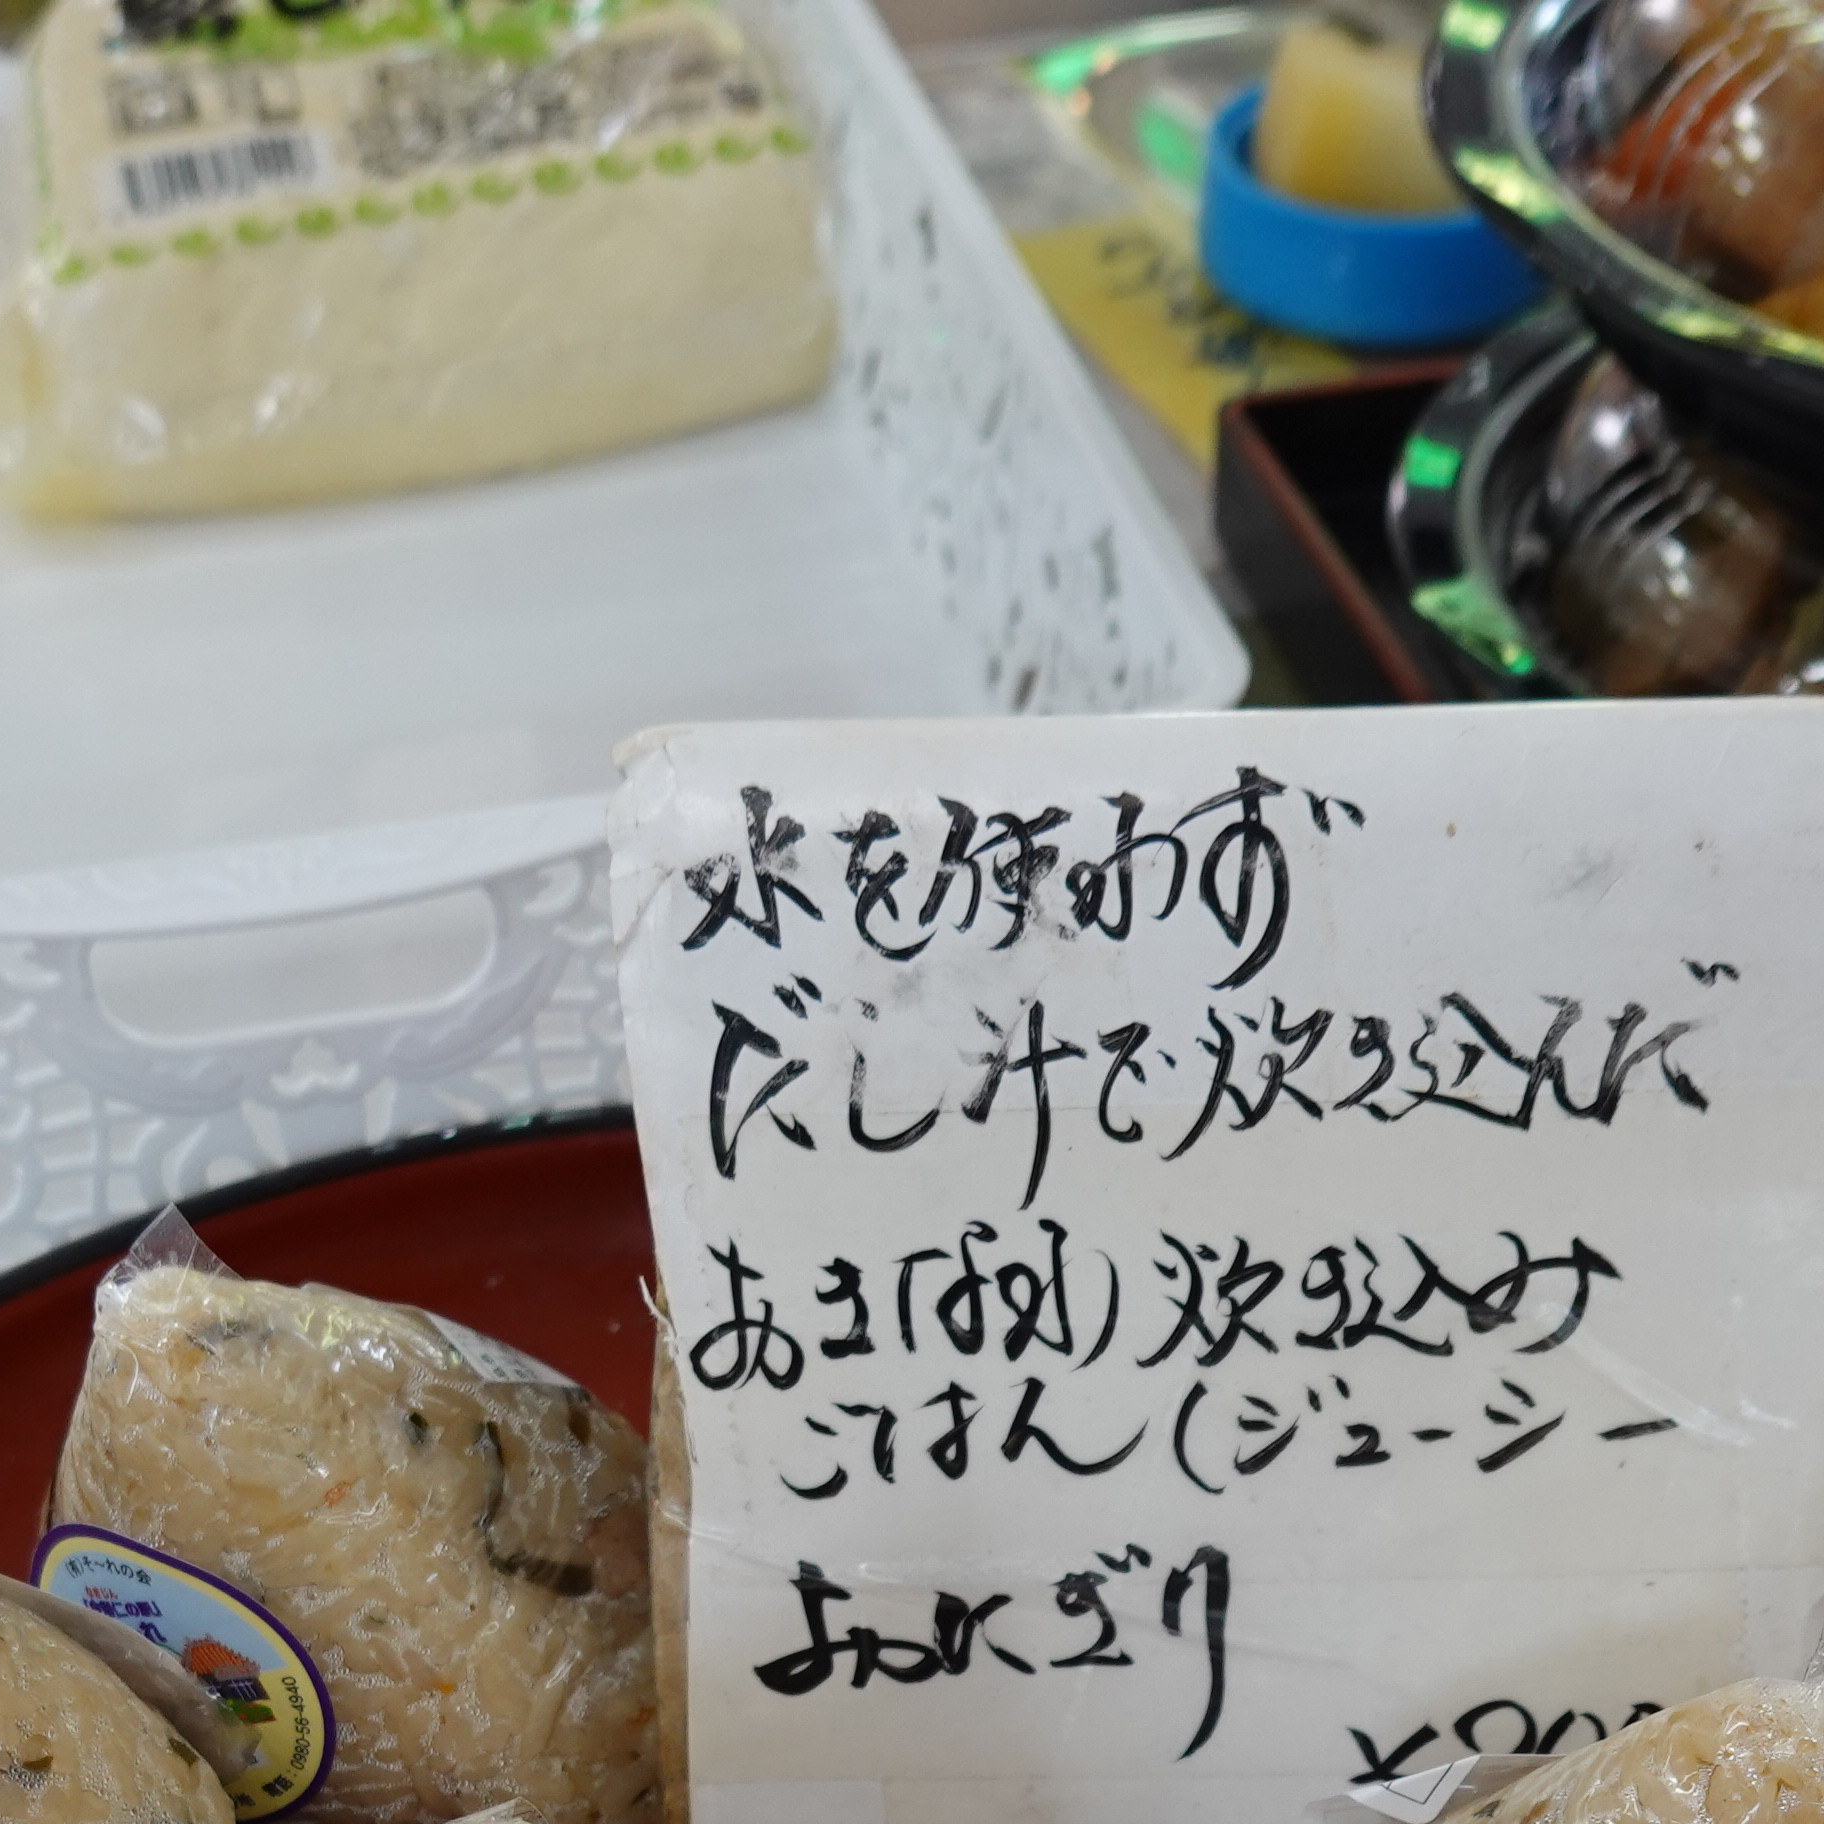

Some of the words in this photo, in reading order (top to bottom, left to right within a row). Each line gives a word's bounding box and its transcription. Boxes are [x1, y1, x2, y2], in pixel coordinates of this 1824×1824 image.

[681, 765, 1366, 990] 水を使わず
[708, 957, 1741, 1210] だし汁で炊き込んだ
